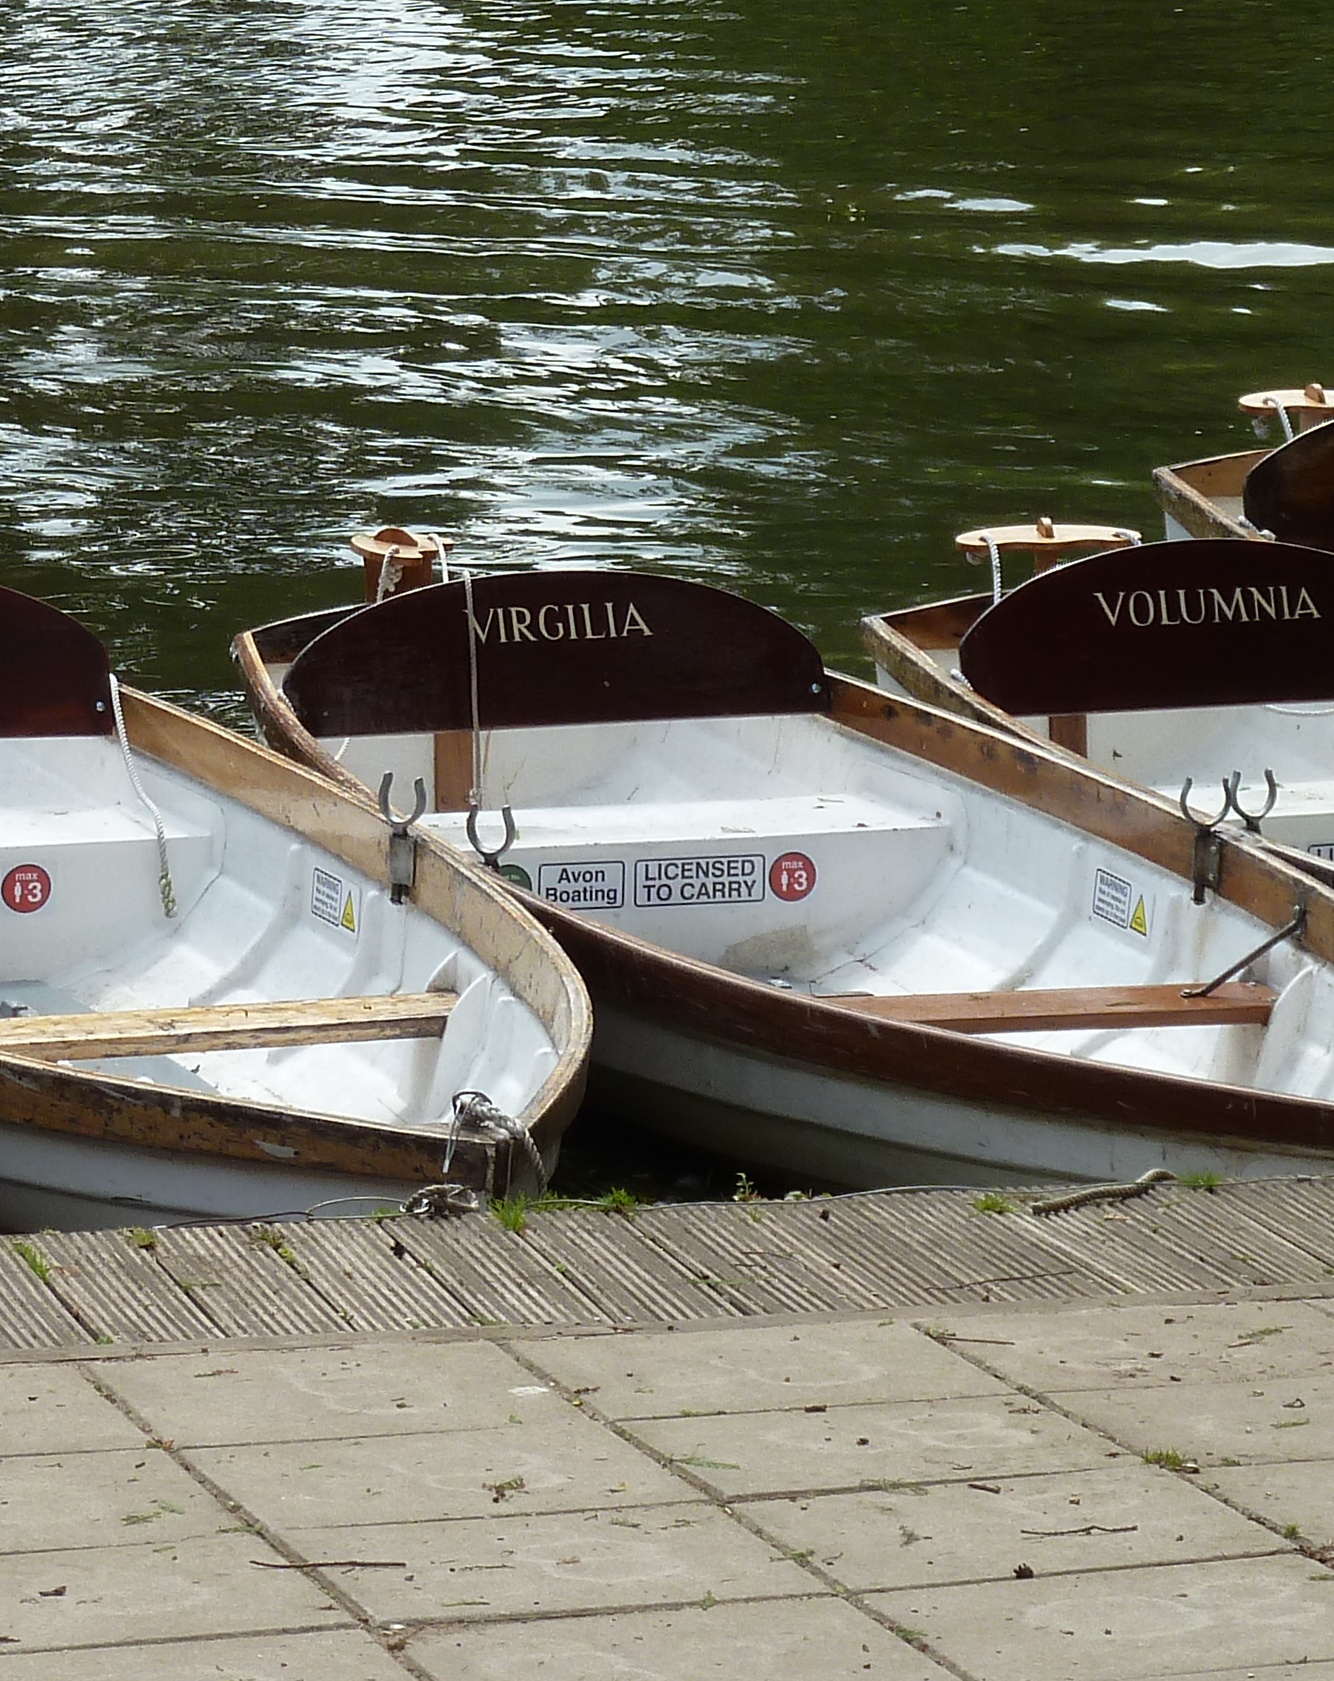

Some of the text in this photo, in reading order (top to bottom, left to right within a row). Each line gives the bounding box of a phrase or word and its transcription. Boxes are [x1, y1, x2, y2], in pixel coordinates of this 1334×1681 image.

[1093, 585, 1322, 627] VOLUMNIA
[462, 602, 654, 645] VIRGILIA
[644, 859, 755, 881] LICENSED
[781, 861, 803, 869] max
[15, 872, 38, 881] max
[558, 868, 605, 884] Avon
[793, 871, 808, 891] 3
[27, 882, 43, 902] 3
[545, 886, 617, 905] Boating
[643, 879, 757, 901] TO CARRY
